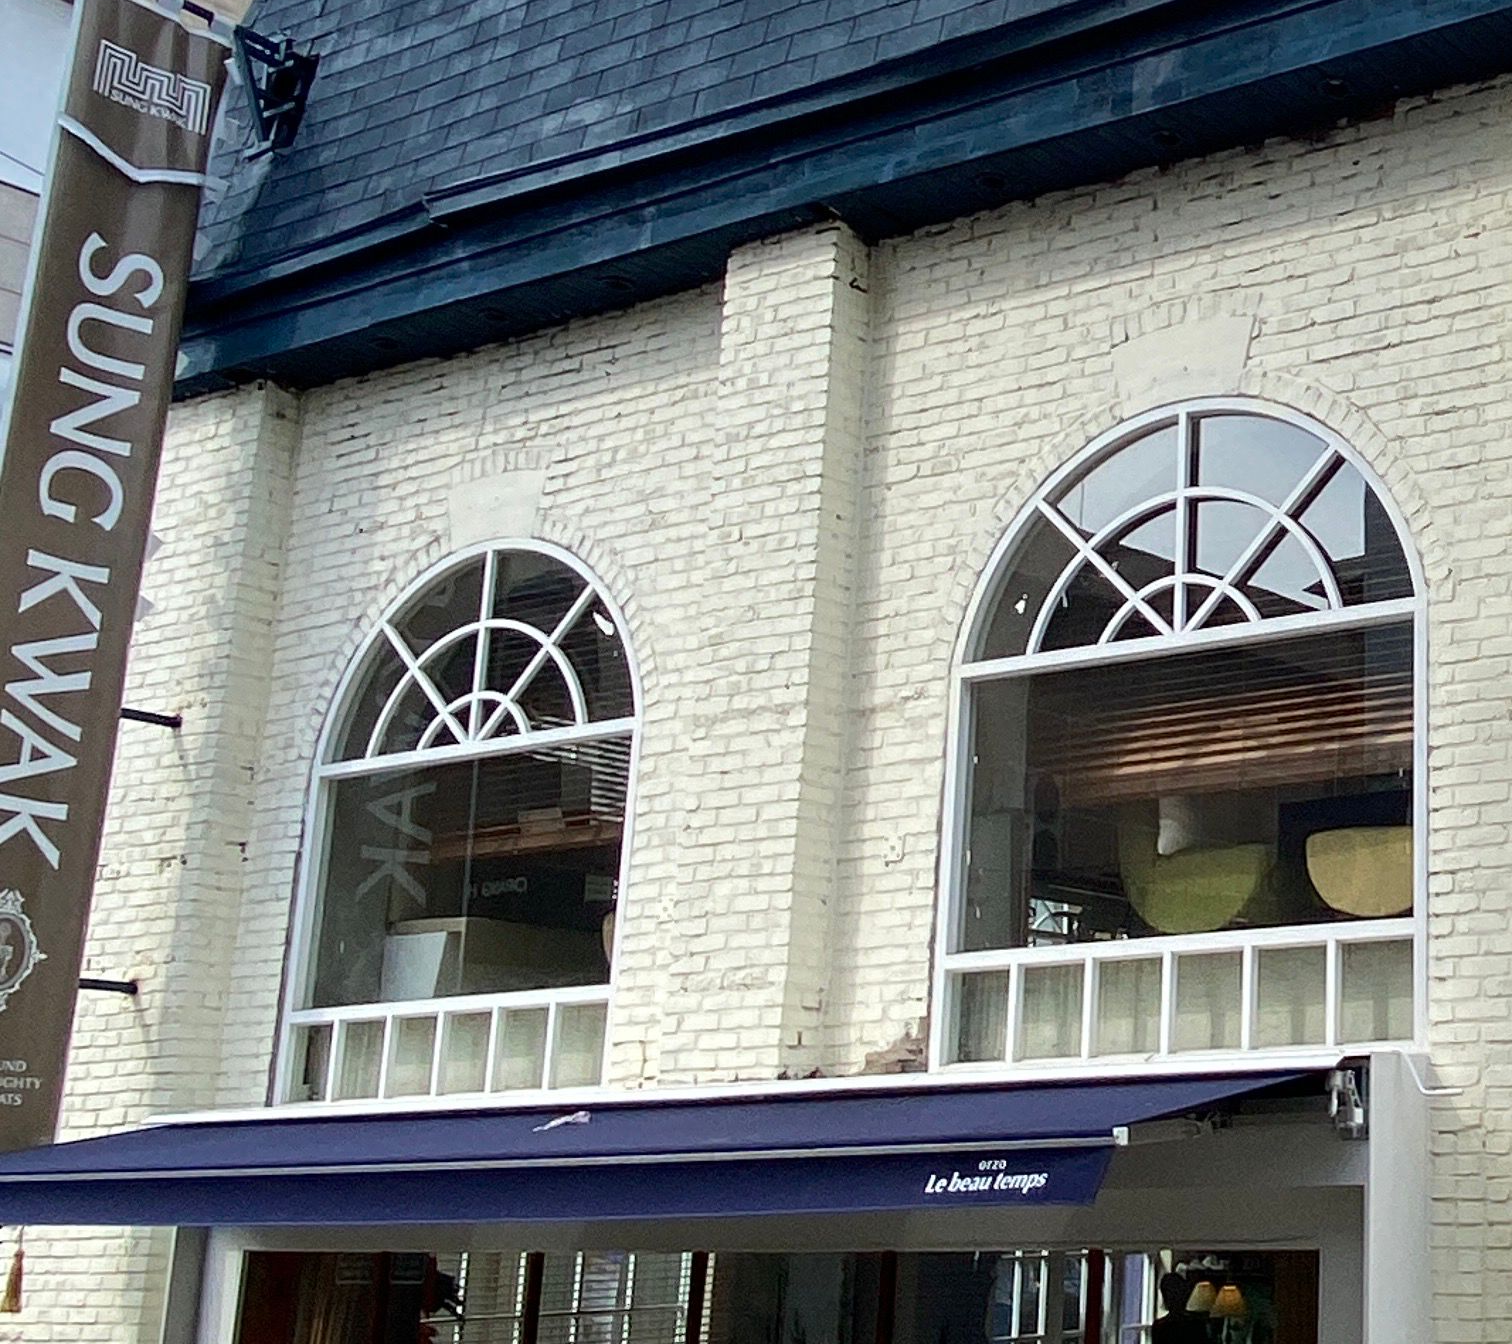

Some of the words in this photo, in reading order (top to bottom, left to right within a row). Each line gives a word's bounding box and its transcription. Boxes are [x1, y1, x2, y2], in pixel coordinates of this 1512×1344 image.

[110, 88, 148, 114] SUNG
[149, 105, 189, 130] KWAK
[38, 231, 164, 531] SUNG
[0, 548, 111, 871] KWAK
[925, 1174, 948, 1193] Le
[947, 1171, 993, 1192] beau
[993, 1172, 1049, 1194] temps
[978, 1159, 1007, 1170] orzo
